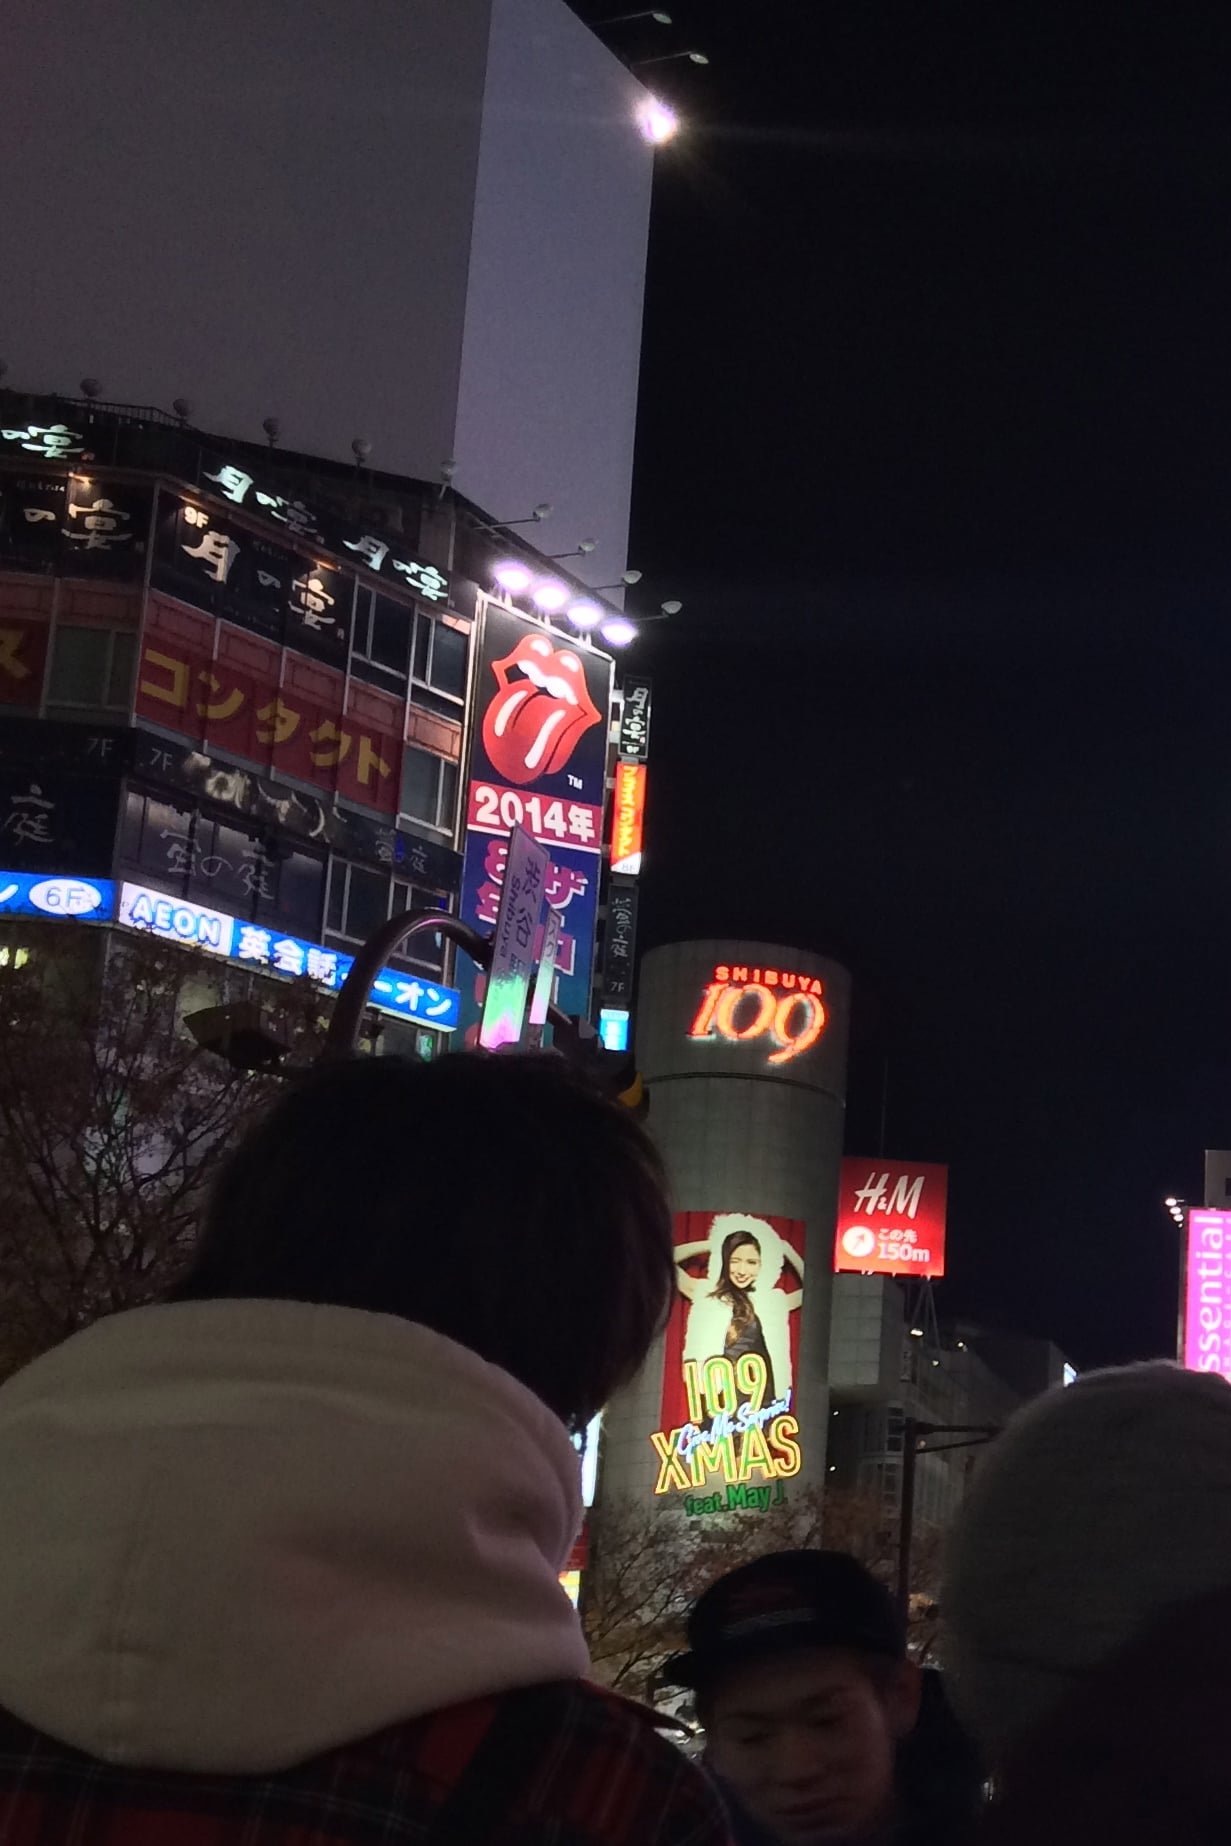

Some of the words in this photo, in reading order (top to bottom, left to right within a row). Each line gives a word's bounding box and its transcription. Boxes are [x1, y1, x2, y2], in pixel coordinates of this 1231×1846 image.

[184, 507, 209, 529] 9F
[140, 648, 392, 786] コンタクト
[475, 786, 595, 842] 2014年
[46, 886, 84, 909] 6F
[131, 892, 220, 946] AEON
[238, 925, 453, 1018] 英会話ーオン
[610, 981, 625, 993] 7F
[715, 966, 823, 995] SHIBUYA
[686, 983, 826, 1064] 109
[854, 1172, 925, 1219] H&M
[878, 1228, 918, 1243] この先
[878, 1243, 931, 1262] 150m
[1194, 1217, 1225, 1373] ssential
[683, 1353, 768, 1423] 109
[650, 1415, 802, 1495] XMAS
[684, 1493, 727, 1517] feat.
[727, 1485, 774, 1514] May
